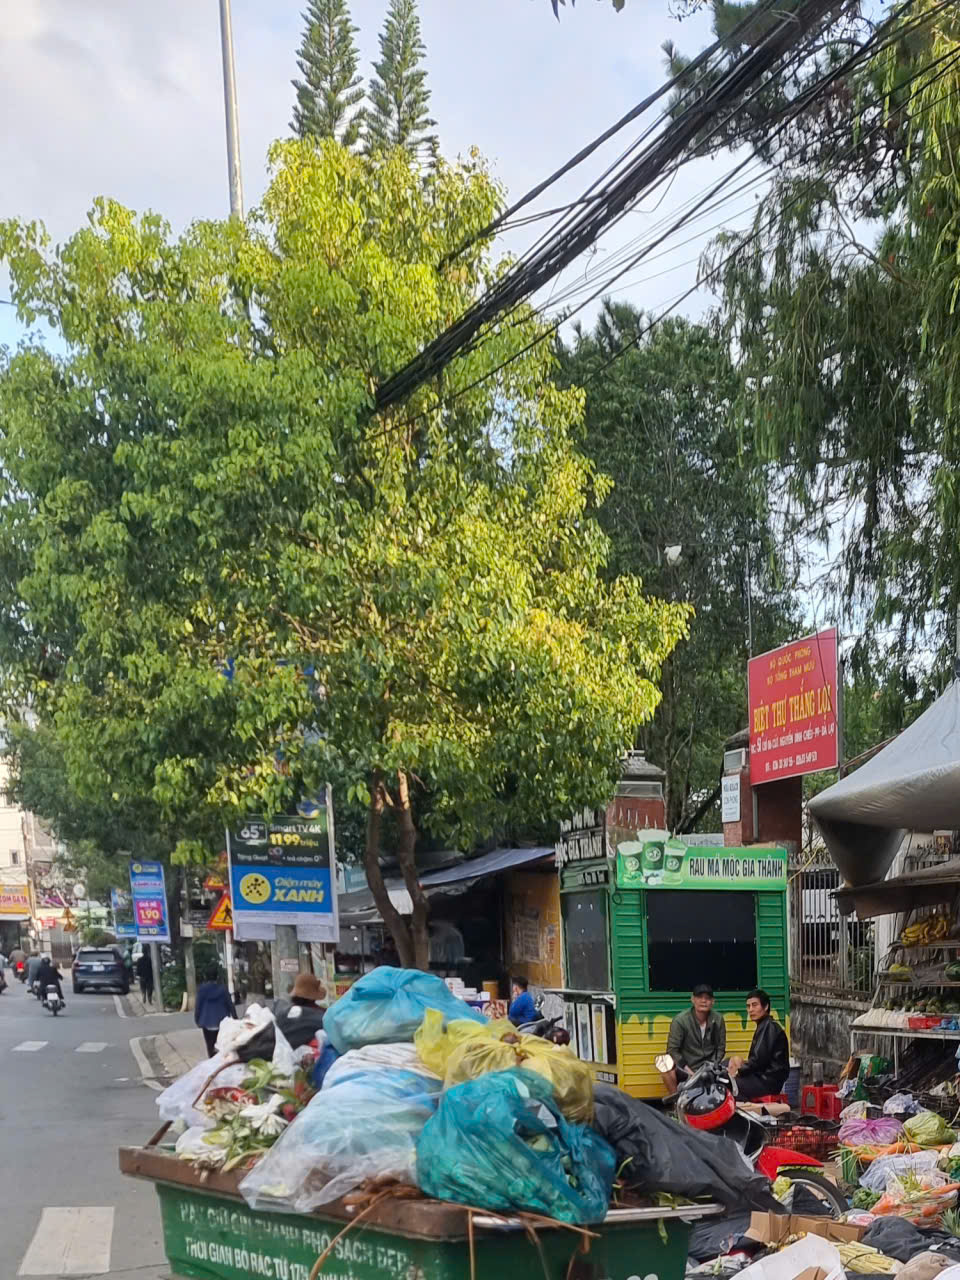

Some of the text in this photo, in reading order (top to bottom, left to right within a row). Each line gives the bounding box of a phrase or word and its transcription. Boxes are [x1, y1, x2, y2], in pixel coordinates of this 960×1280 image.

[309, 824, 321, 834] 4K
[689, 858, 705, 876] RAU
[742, 859, 755, 877] GIA
[758, 855, 783, 878] THÀNH
[273, 889, 324, 903] XANH
[209, 1242, 234, 1266] GIAN
[250, 1250, 273, 1277] RÁC
